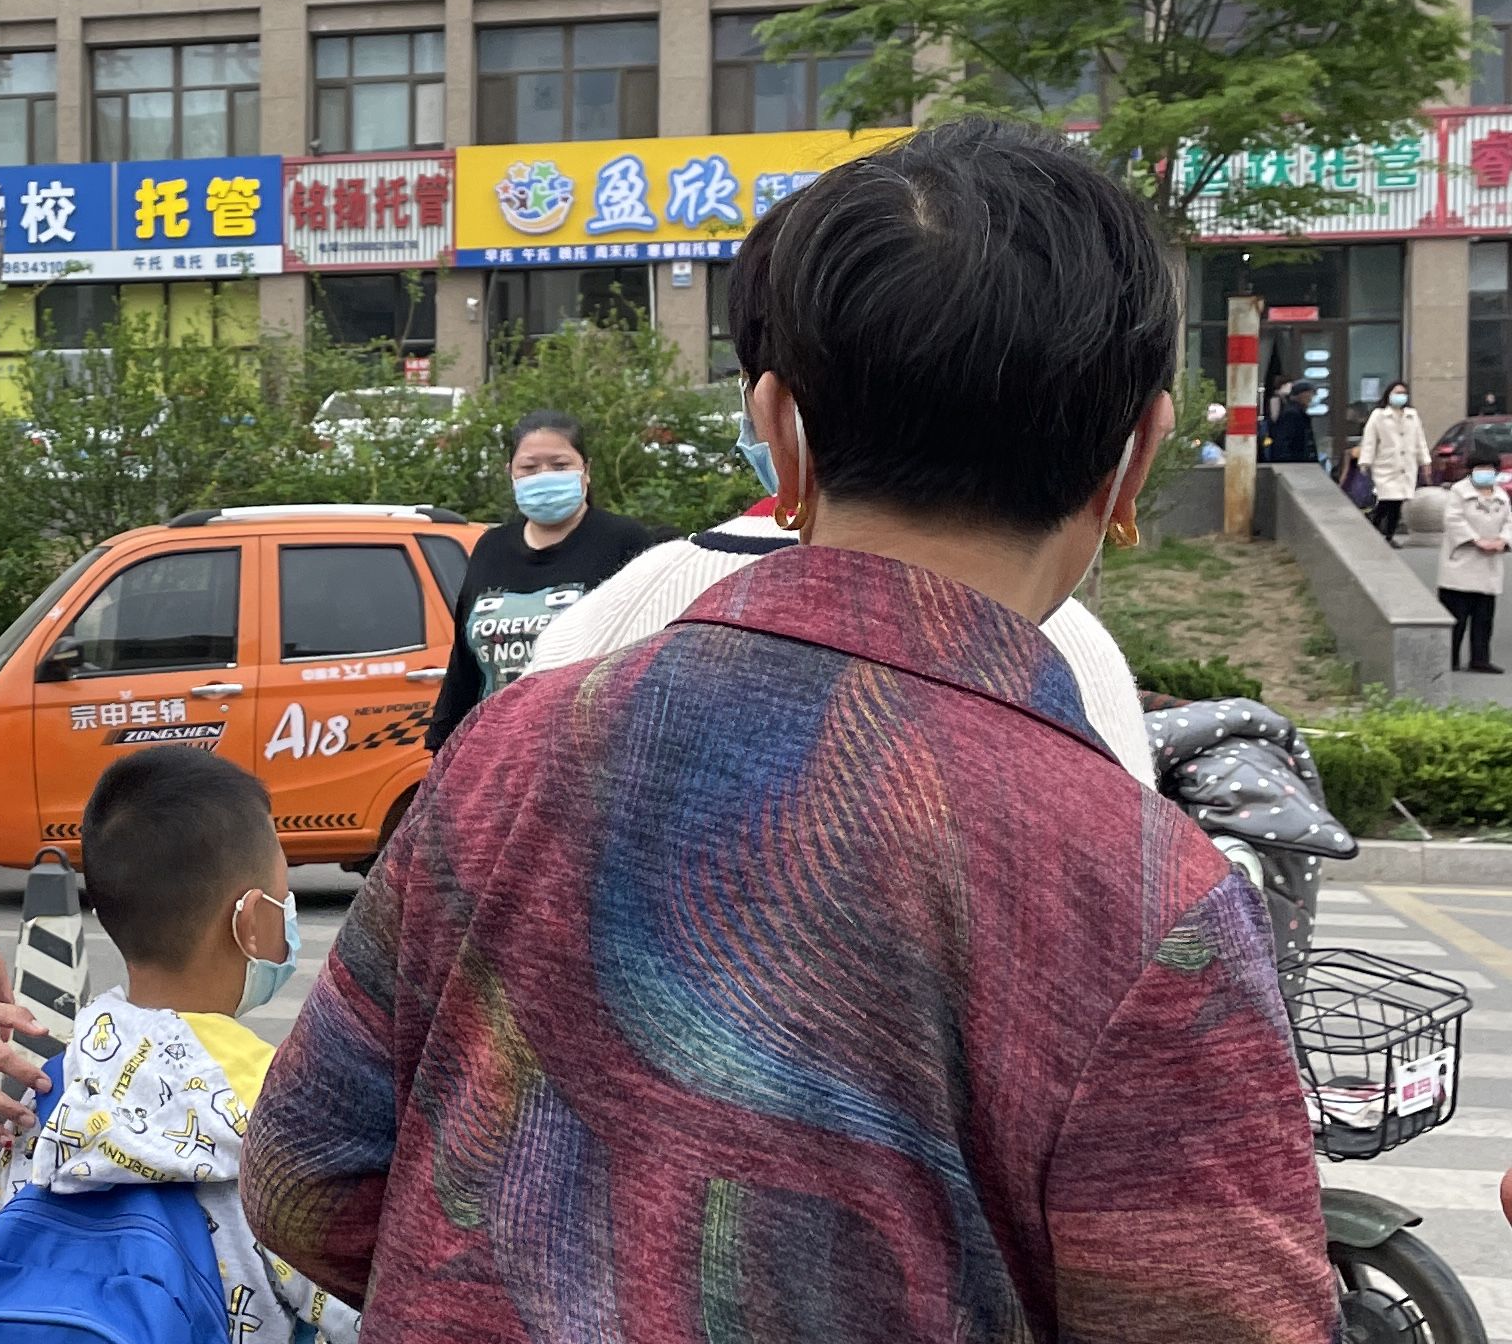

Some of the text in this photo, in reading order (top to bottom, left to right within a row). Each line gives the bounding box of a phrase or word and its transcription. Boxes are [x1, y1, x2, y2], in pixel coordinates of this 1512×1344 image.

[135, 176, 262, 239] 托管
[587, 156, 741, 232] 盈欣
[134, 256, 162, 270] 午托
[472, 613, 560, 639] FOREVE
[71, 698, 186, 730] 宗申车辆
[355, 706, 385, 717] NEW
[124, 725, 223, 743] ZONGSHEN
[264, 702, 349, 760] A18
